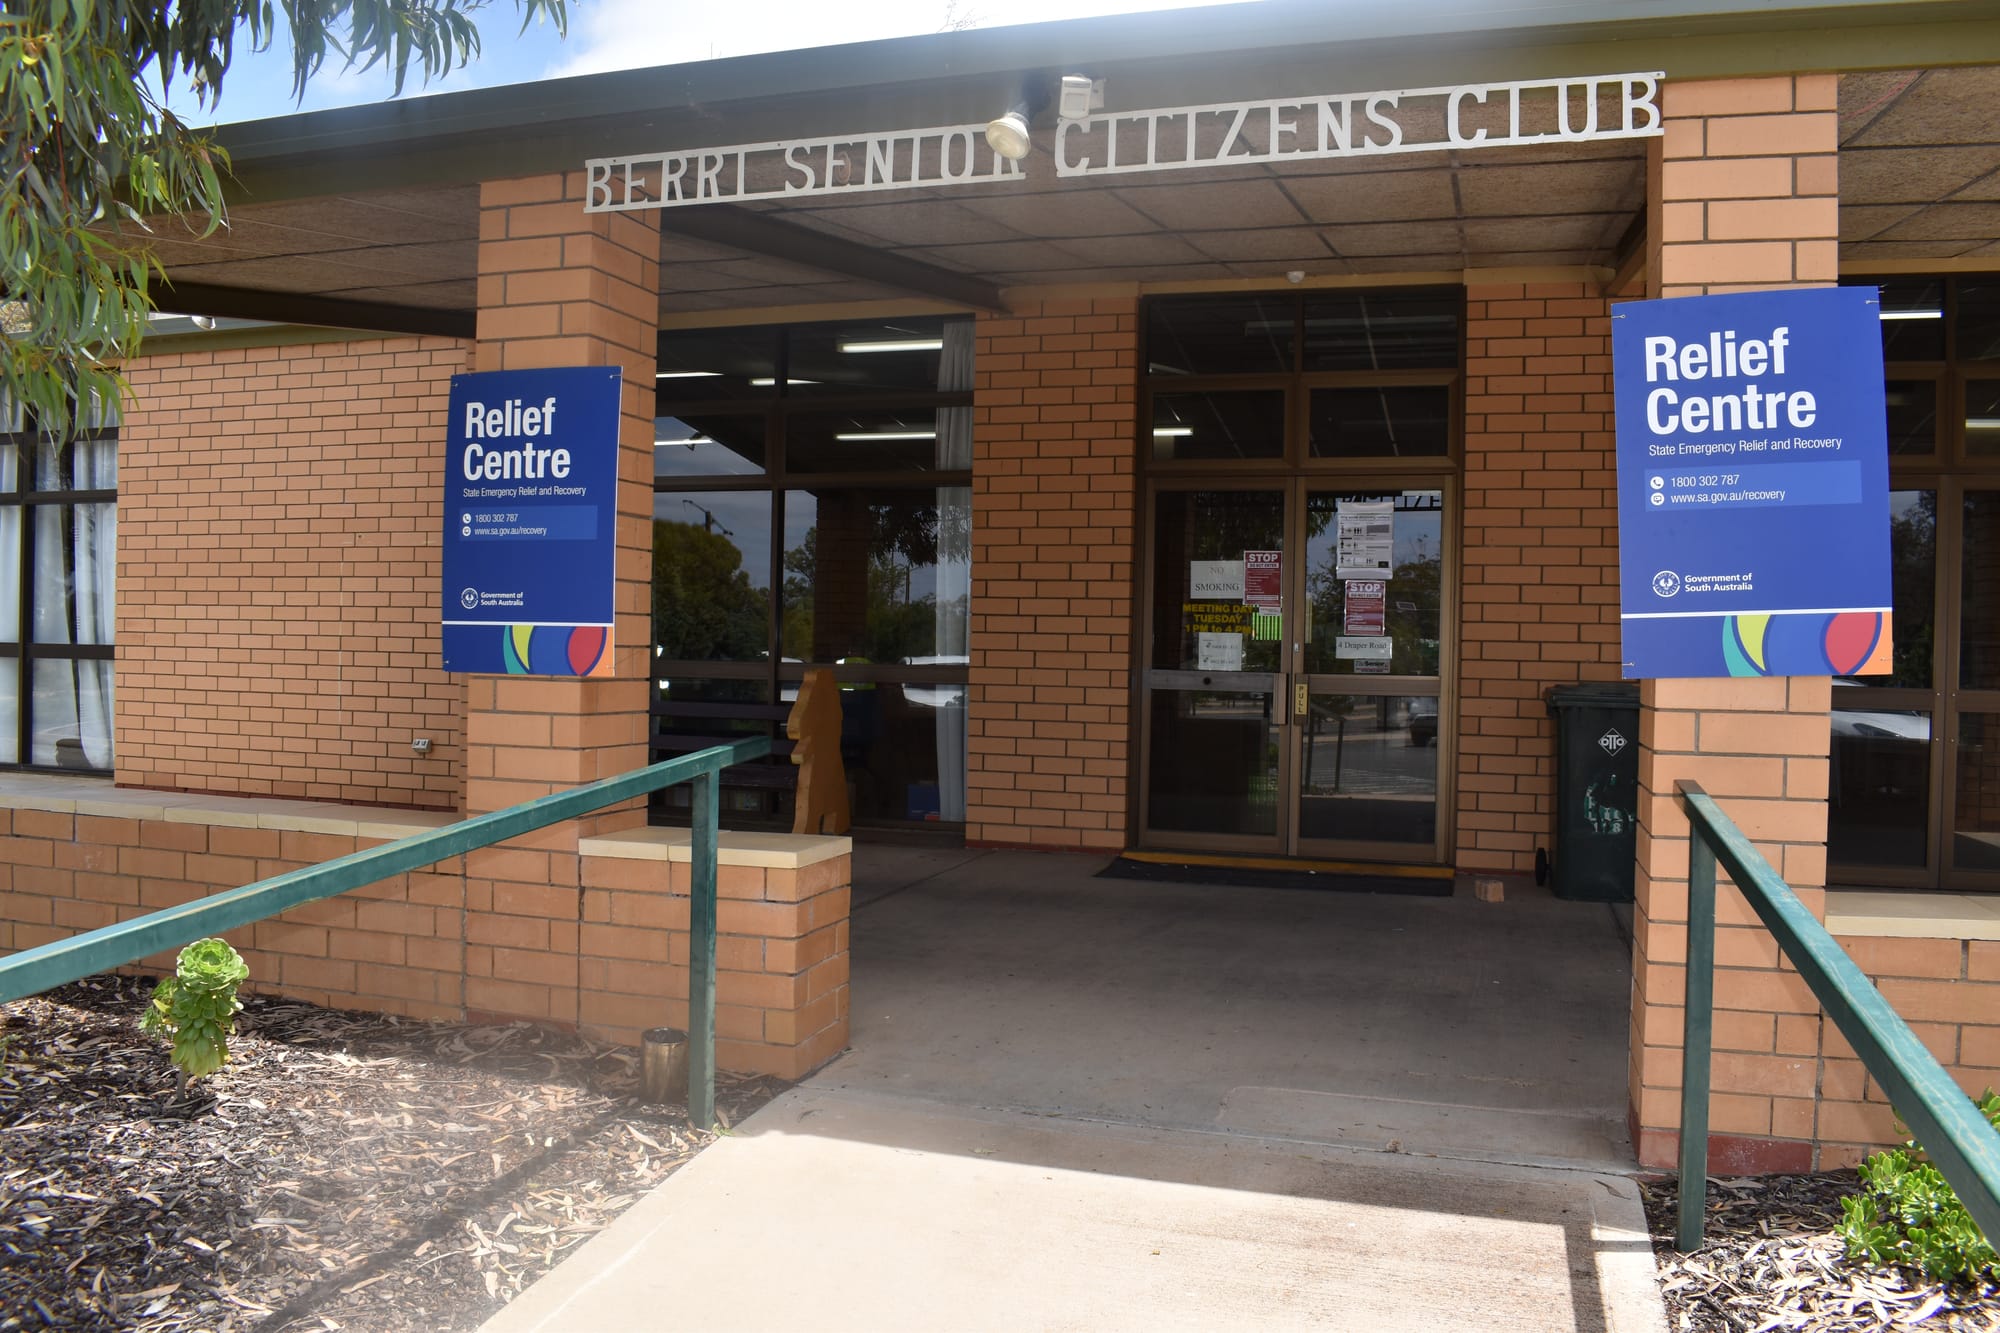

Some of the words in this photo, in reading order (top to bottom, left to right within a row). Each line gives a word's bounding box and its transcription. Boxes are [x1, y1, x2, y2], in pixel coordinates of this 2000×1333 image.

[584, 149, 747, 213] BERRI
[1055, 90, 1404, 177] CITIZENS
[1447, 71, 1664, 146] CLUB
[1645, 327, 1790, 382] Relief
[1647, 384, 1817, 435] Centre
[465, 397, 556, 438] Relief
[1649, 444, 1676, 456] State
[1679, 442, 1736, 455] Emergency
[1739, 439, 1768, 451] Relief
[1771, 439, 1791, 449] and
[1794, 437, 1842, 450] Recovery
[463, 442, 571, 481] Centre
[1671, 476, 1697, 487] 1800
[1699, 475, 1718, 486] 302
[1721, 474, 1740, 485] 787
[463, 488, 480, 497] State
[481, 487, 517, 498] Emergency
[518, 486, 537, 496] Relief
[539, 486, 552, 495] and
[553, 486, 587, 496] Recovery
[1671, 490, 1786, 504] www.sa.gov.au/recovery
[492, 514, 504, 522] 302
[506, 514, 519, 522] 787
[474, 526, 547, 536] www.sa.gov.au/recovery
[1249, 553, 1278, 562] STOP
[1208, 567, 1224, 575] NO
[1685, 574, 1740, 583] Government
[1742, 572, 1753, 580] of
[1195, 583, 1240, 591] SMOKING
[1350, 583, 1380, 592] STOP
[1684, 584, 1711, 592] South
[1713, 582, 1753, 591] Australia
[1183, 604, 1230, 612] MEETING
[1233, 605, 1253, 613] DAY
[1194, 614, 1242, 623] TUESDAY
[1345, 642, 1367, 650] Draper
